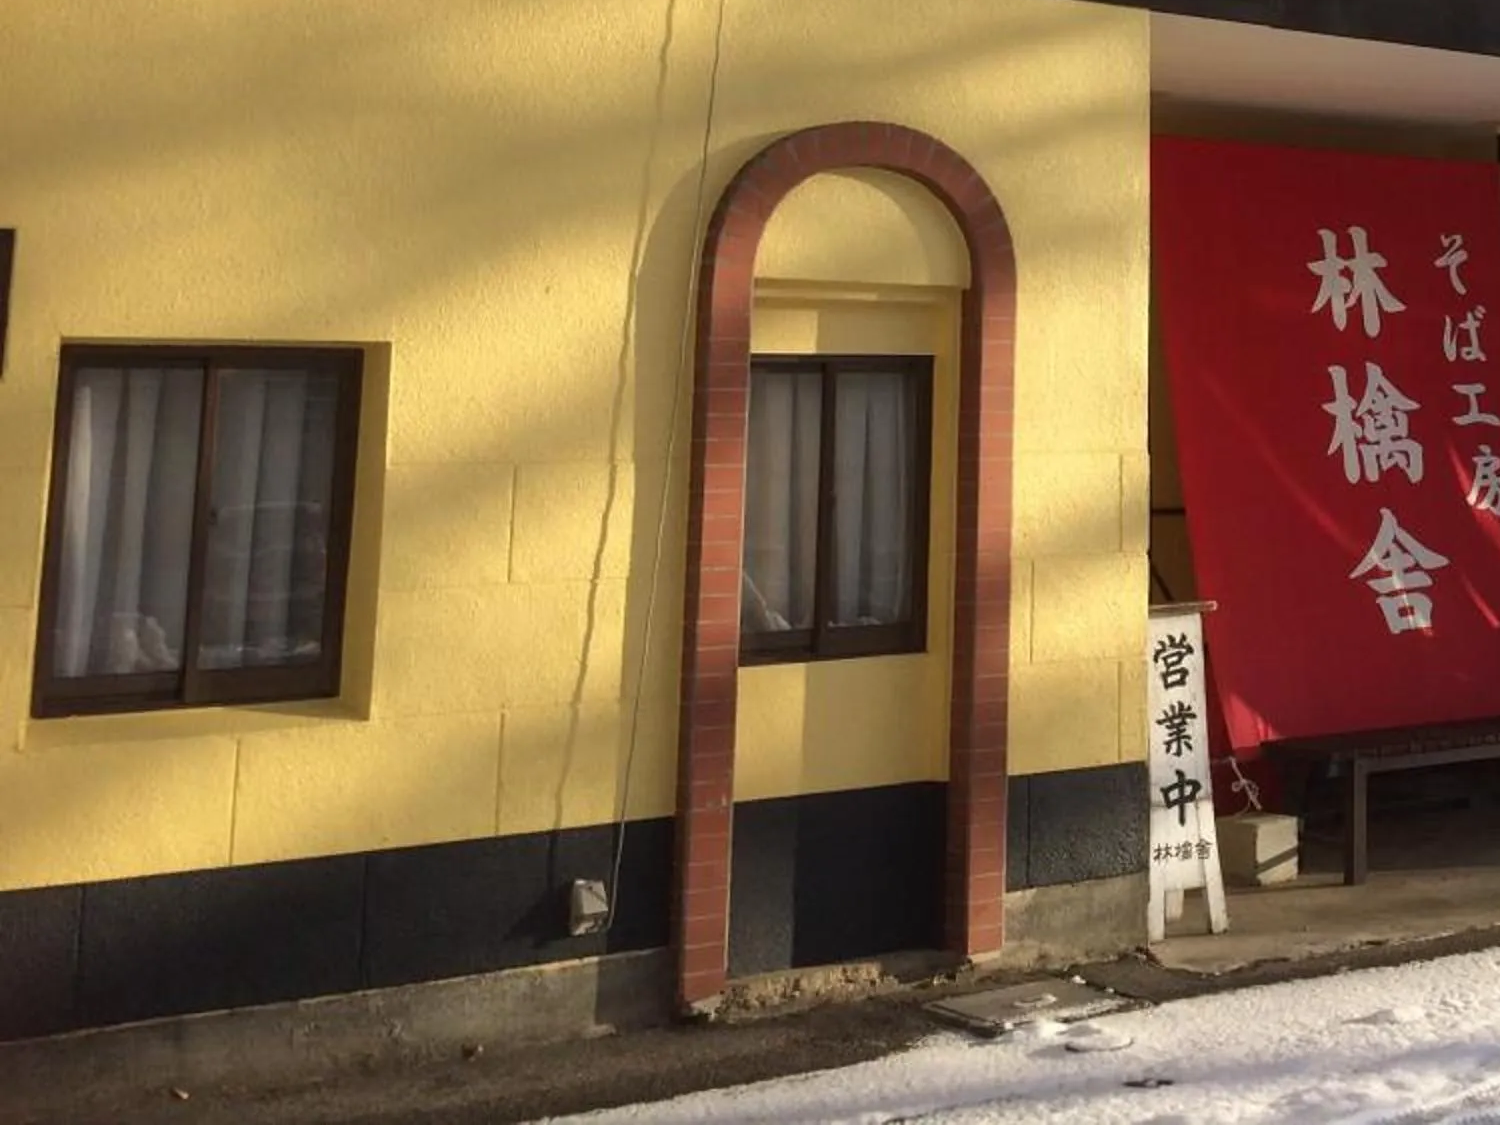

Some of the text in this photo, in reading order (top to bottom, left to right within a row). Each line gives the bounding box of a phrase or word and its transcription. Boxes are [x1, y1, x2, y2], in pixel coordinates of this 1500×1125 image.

[1306, 225, 1450, 635] 林檎舎
[1152, 631, 1202, 826] 営業中
[1152, 838, 1213, 865] 林檎舎
